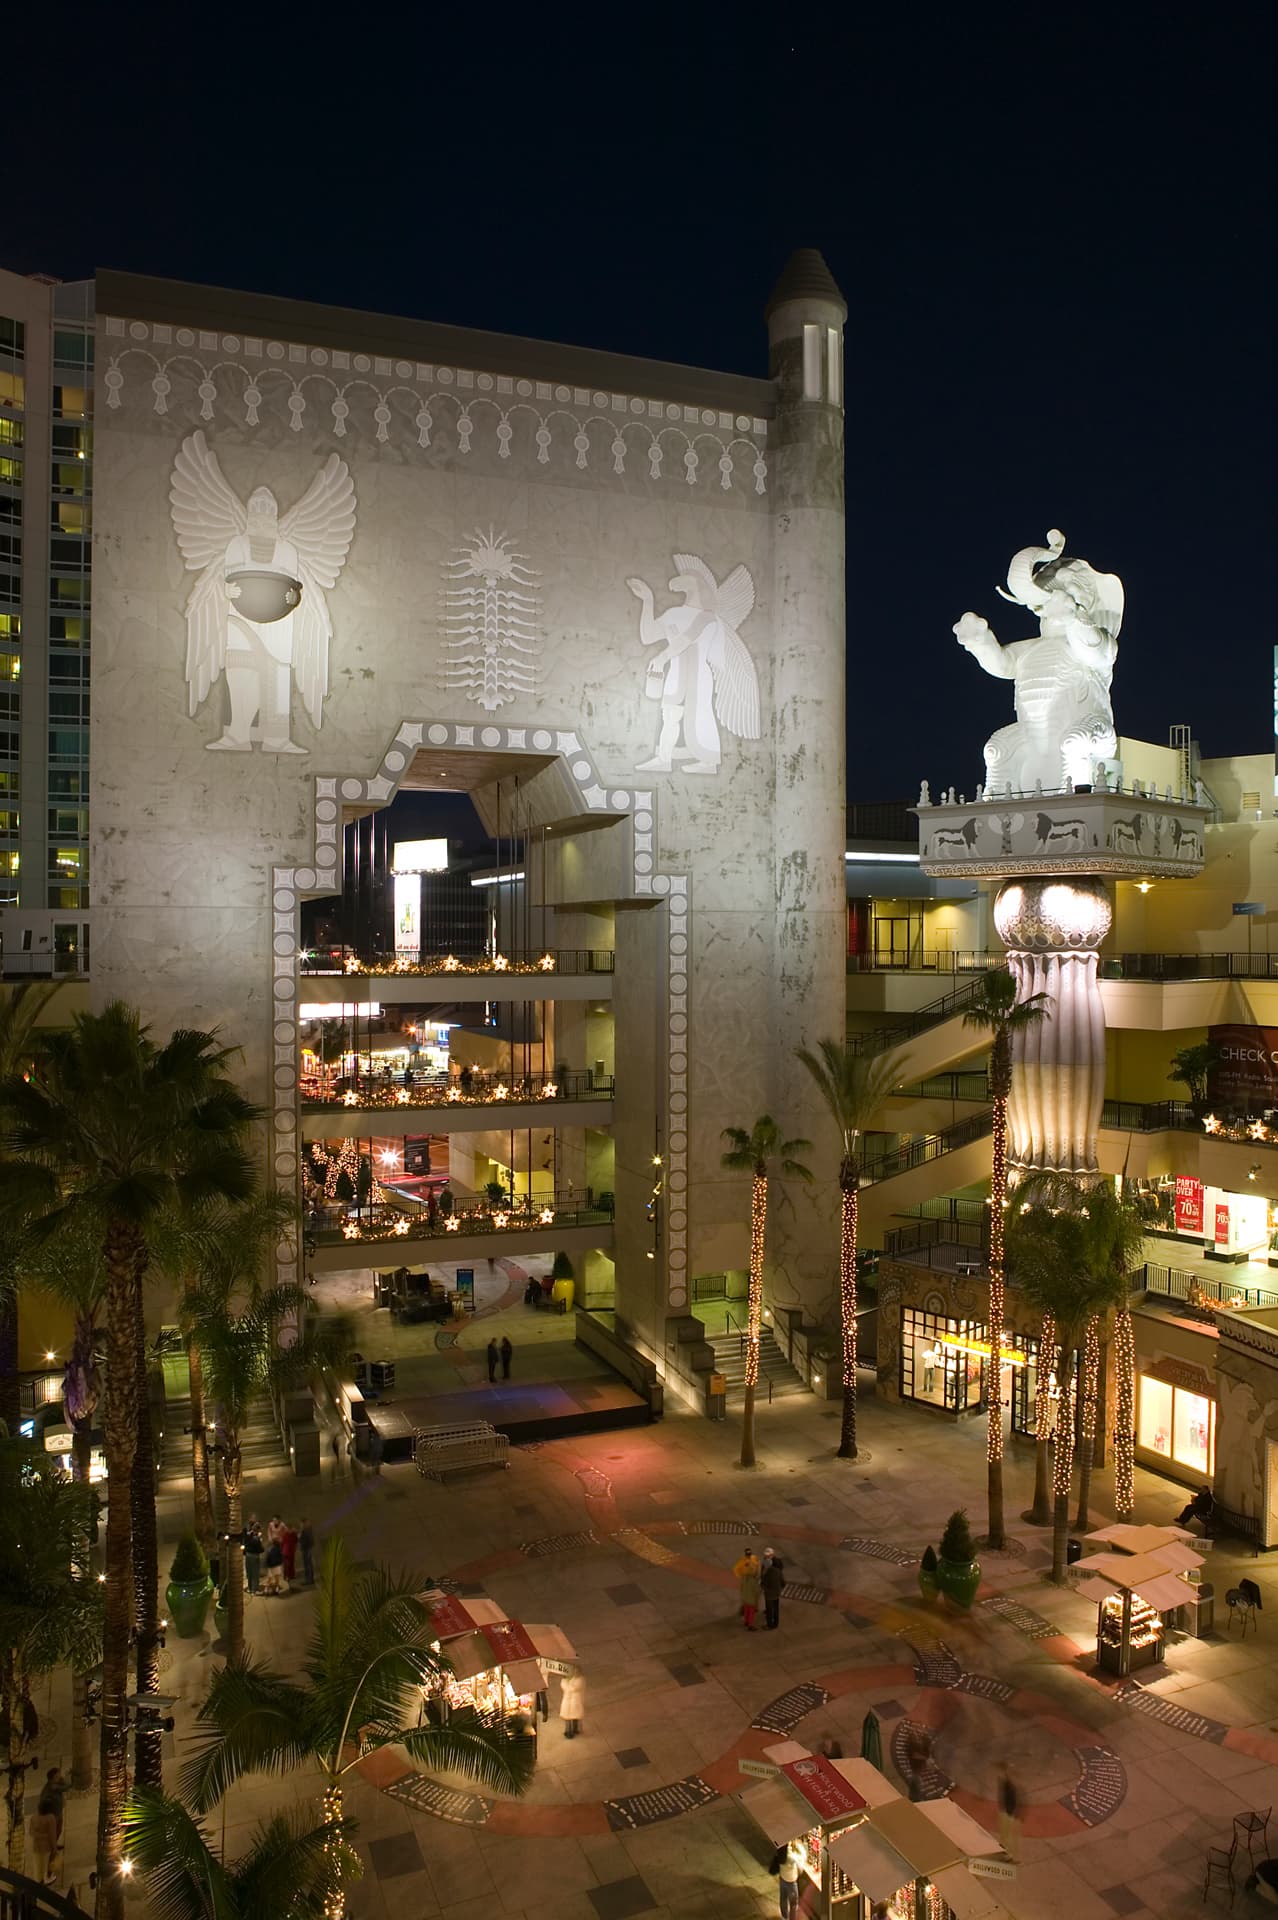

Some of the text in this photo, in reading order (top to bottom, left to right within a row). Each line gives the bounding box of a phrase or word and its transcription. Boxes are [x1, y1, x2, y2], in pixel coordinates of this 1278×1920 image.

[1220, 1047, 1267, 1063] CHECK
[1176, 1186, 1194, 1197] OVER
[803, 1776, 840, 1814] HIGHLAND
[818, 1772, 854, 1809] HOLLYWOOD
